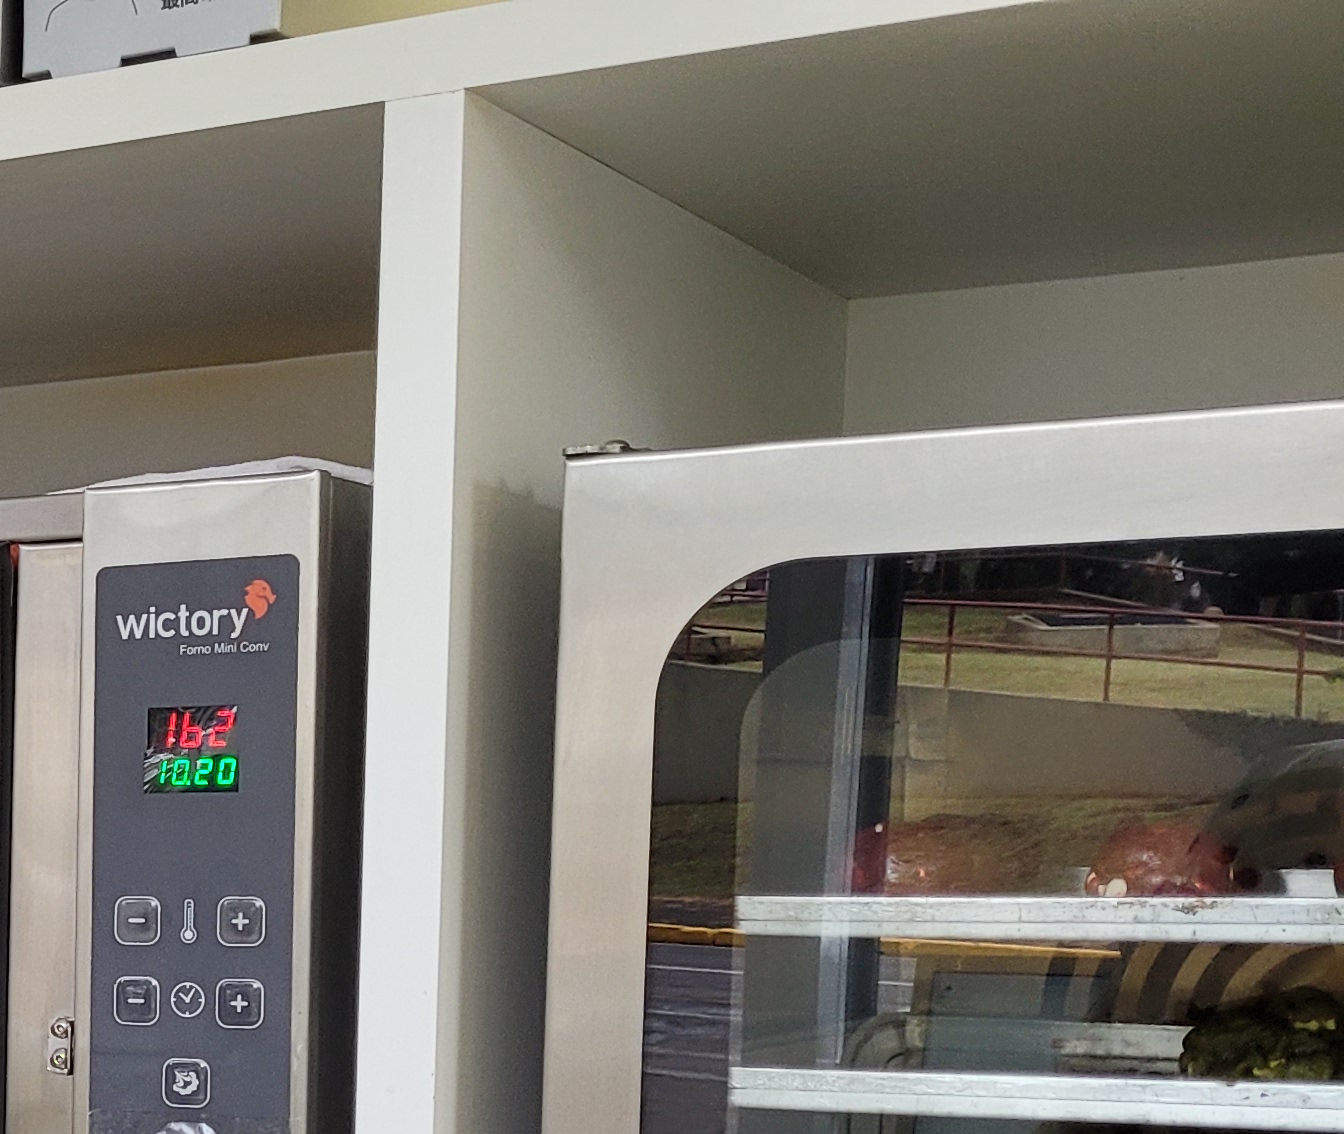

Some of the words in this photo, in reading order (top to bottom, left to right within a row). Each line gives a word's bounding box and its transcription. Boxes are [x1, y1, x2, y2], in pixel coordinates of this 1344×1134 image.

[115, 604, 250, 640] wictory
[214, 642, 237, 654] Mini
[239, 641, 270, 653] Conv
